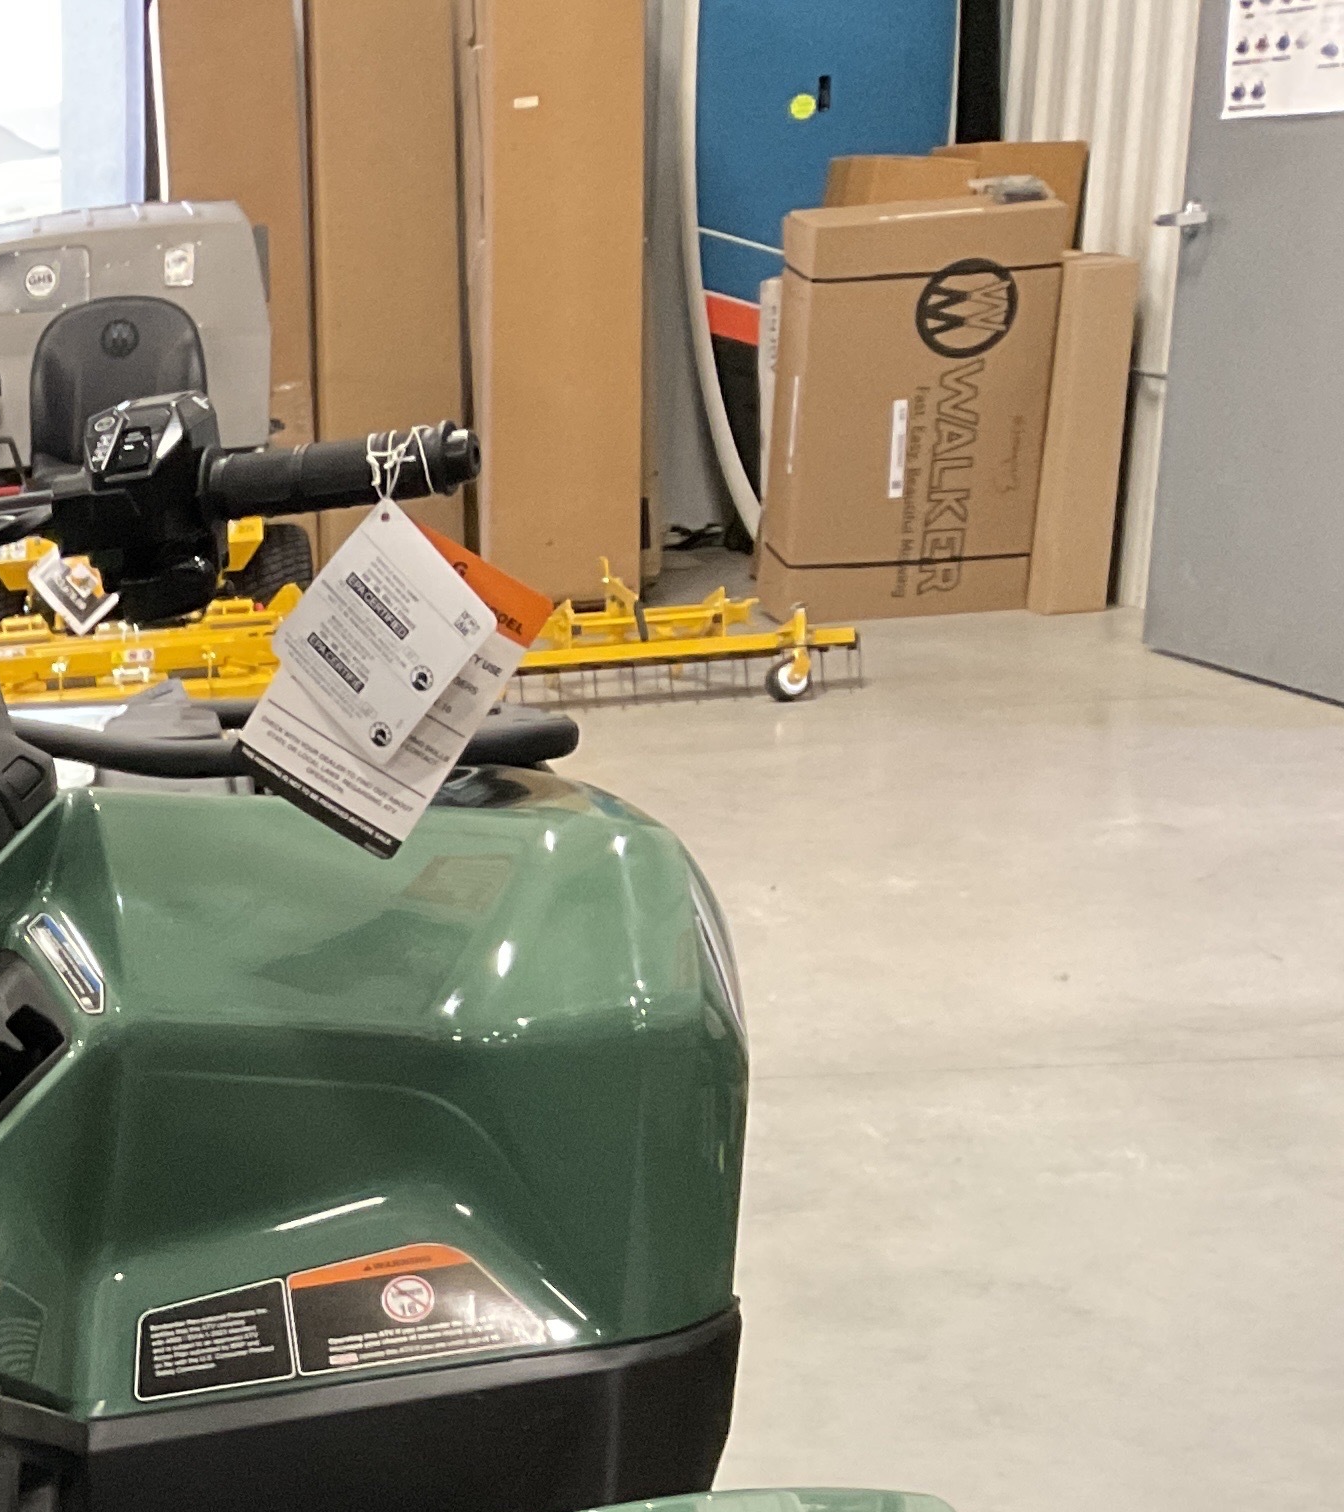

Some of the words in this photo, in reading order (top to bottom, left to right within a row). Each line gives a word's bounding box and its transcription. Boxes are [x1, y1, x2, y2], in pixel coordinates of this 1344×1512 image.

[916, 357, 987, 597] WALKER
[346, 573, 370, 598] EPA
[361, 589, 408, 638] CERTIFIED
